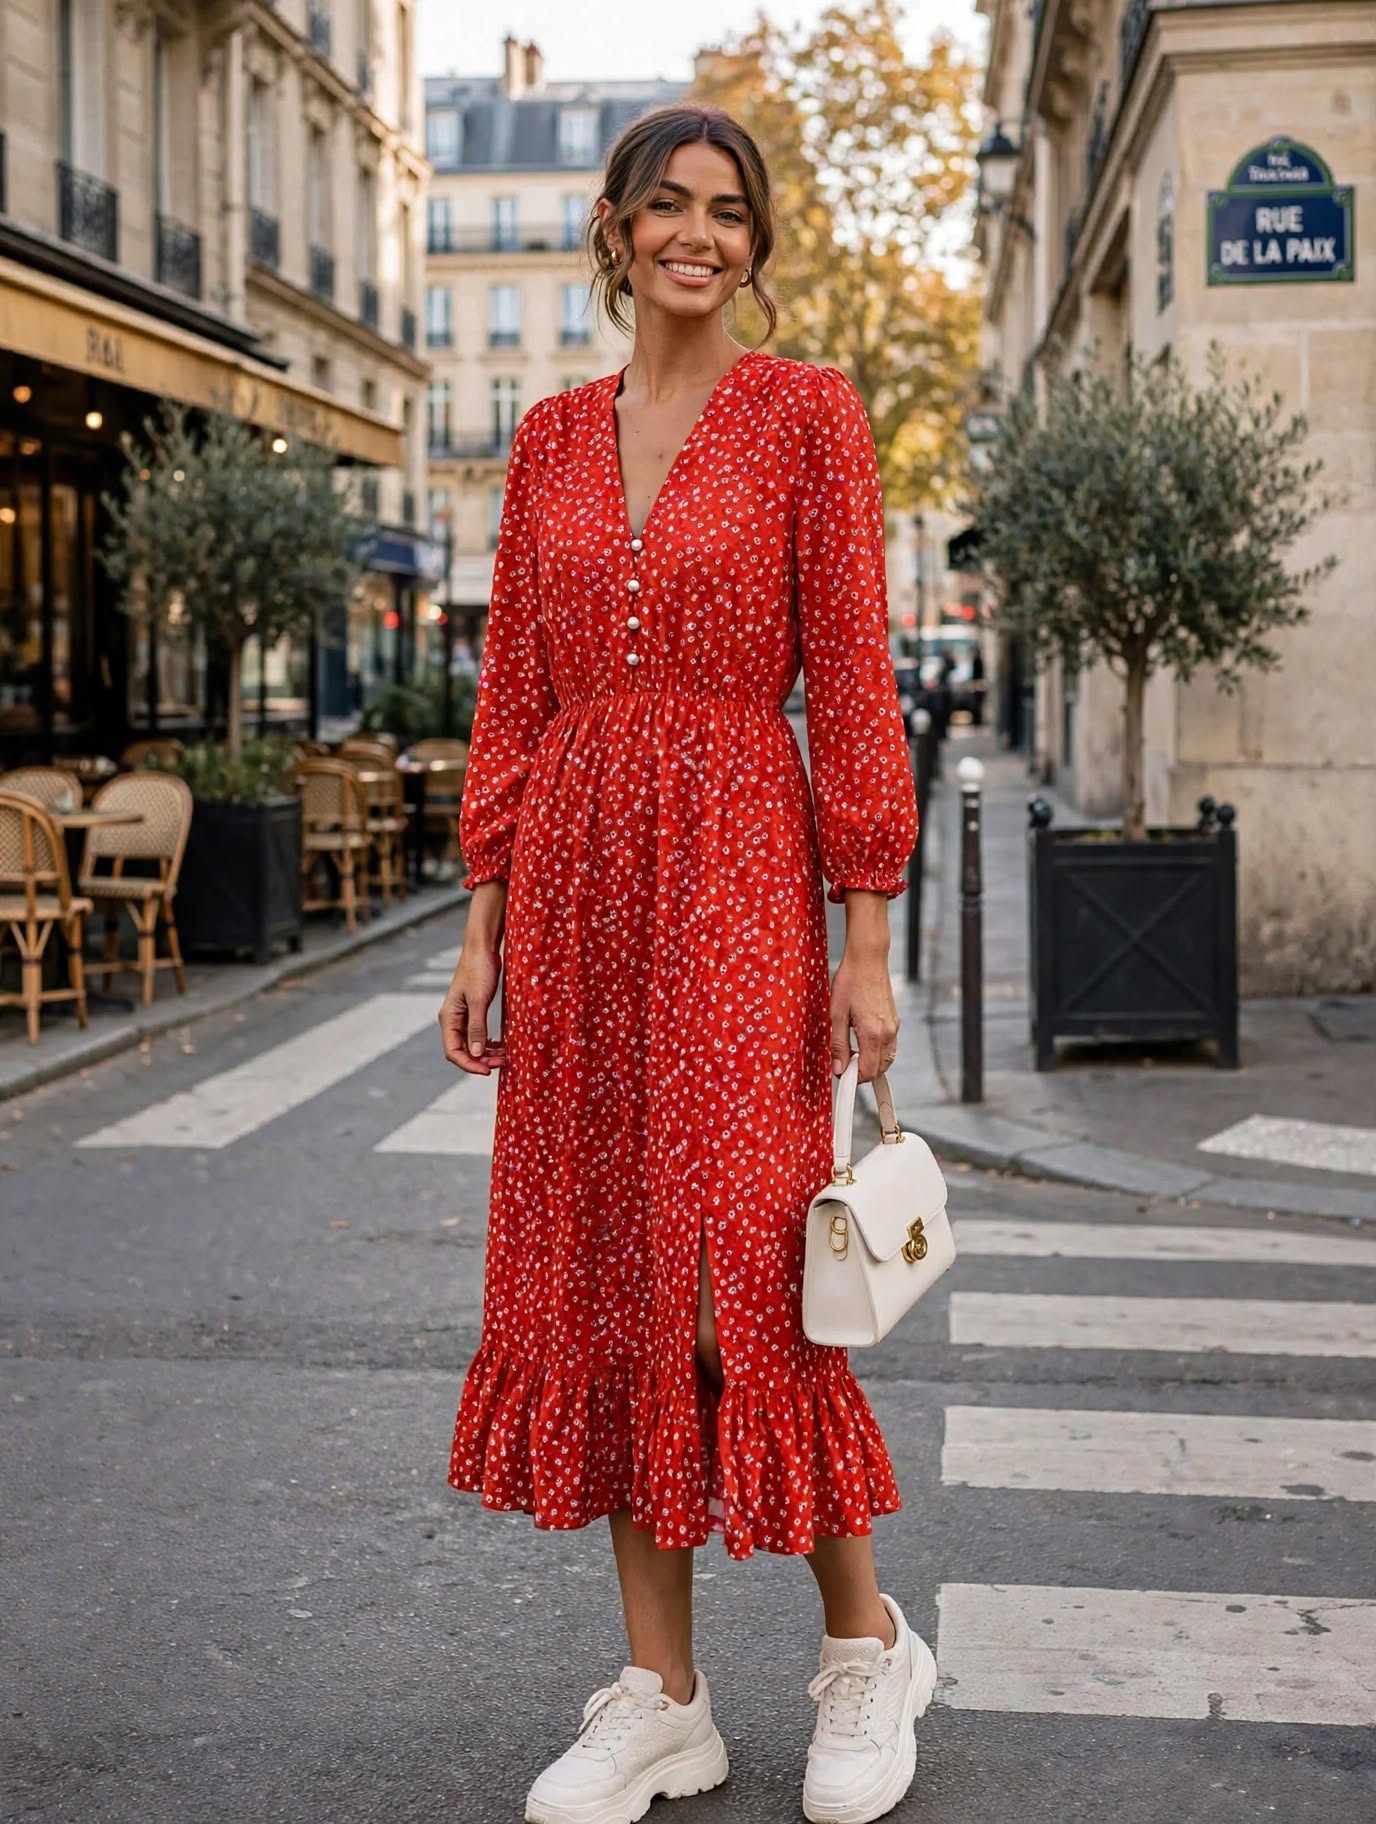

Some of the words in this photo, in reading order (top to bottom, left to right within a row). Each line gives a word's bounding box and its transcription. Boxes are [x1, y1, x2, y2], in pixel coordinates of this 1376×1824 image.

[1256, 206, 1303, 233] RUE
[1220, 240, 1249, 265] DE
[1253, 238, 1282, 265] LA
[1286, 237, 1336, 263] PAIX
